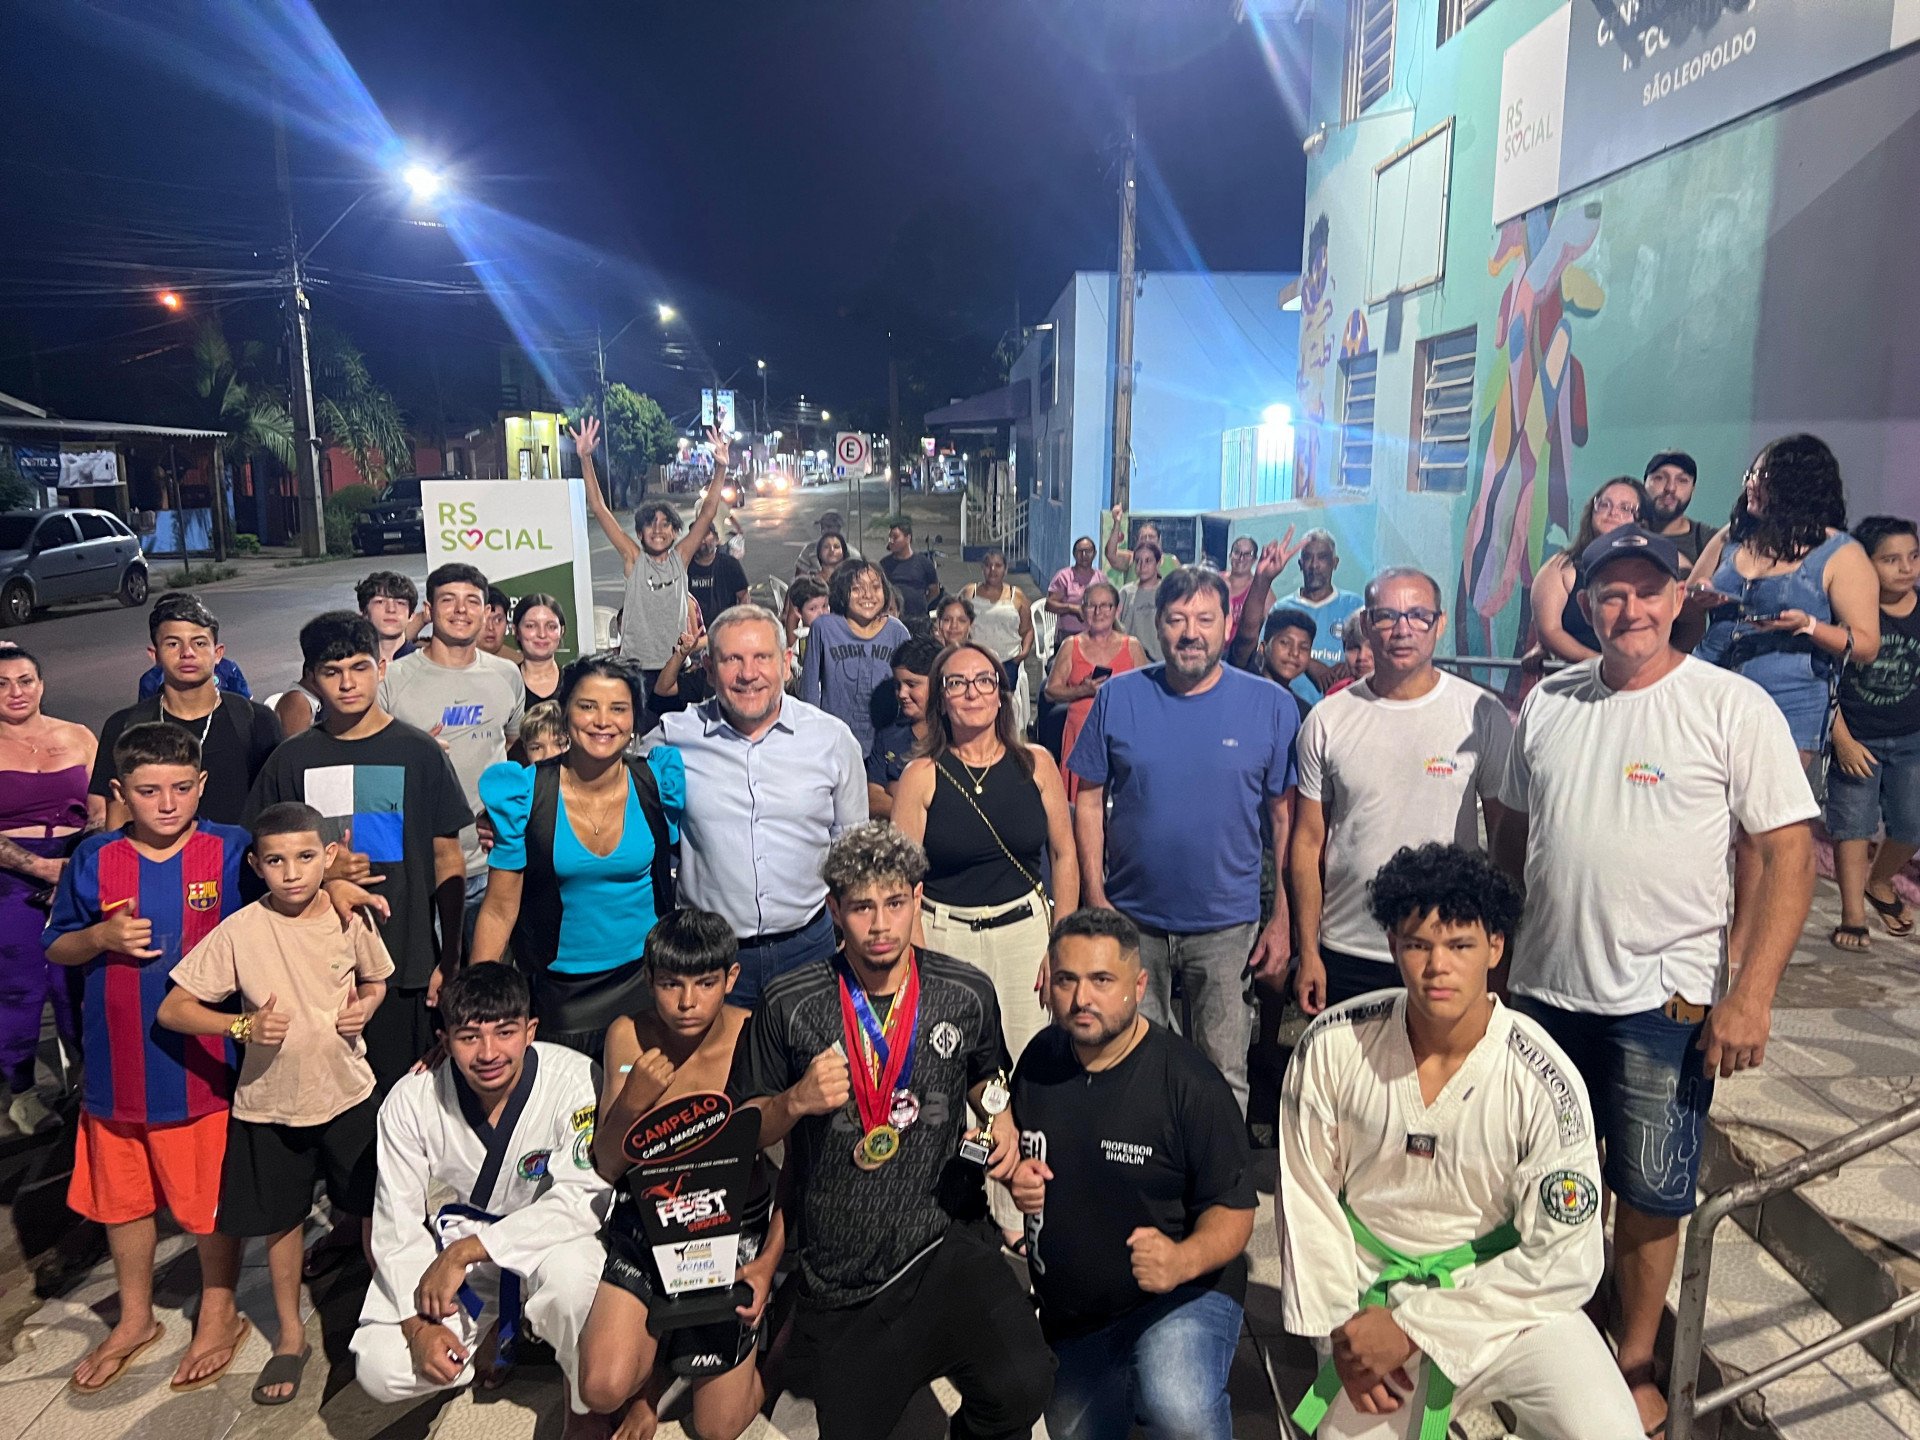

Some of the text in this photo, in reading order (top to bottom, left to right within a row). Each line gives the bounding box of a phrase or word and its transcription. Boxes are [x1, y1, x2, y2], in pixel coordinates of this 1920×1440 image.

[1643, 71, 1671, 106] SÃO
[1673, 26, 1756, 91] LEOPOLDO
[1506, 98, 1523, 134] RS
[846, 441, 855, 459] E
[438, 502, 478, 526] RS
[441, 704, 484, 727] NIKE
[632, 1097, 718, 1149] CAMPEÃO
[1101, 1139, 1153, 1167] PROFESSOR
[1105, 1150, 1145, 1165] SHAOLIN
[657, 1188, 728, 1228] FEST
